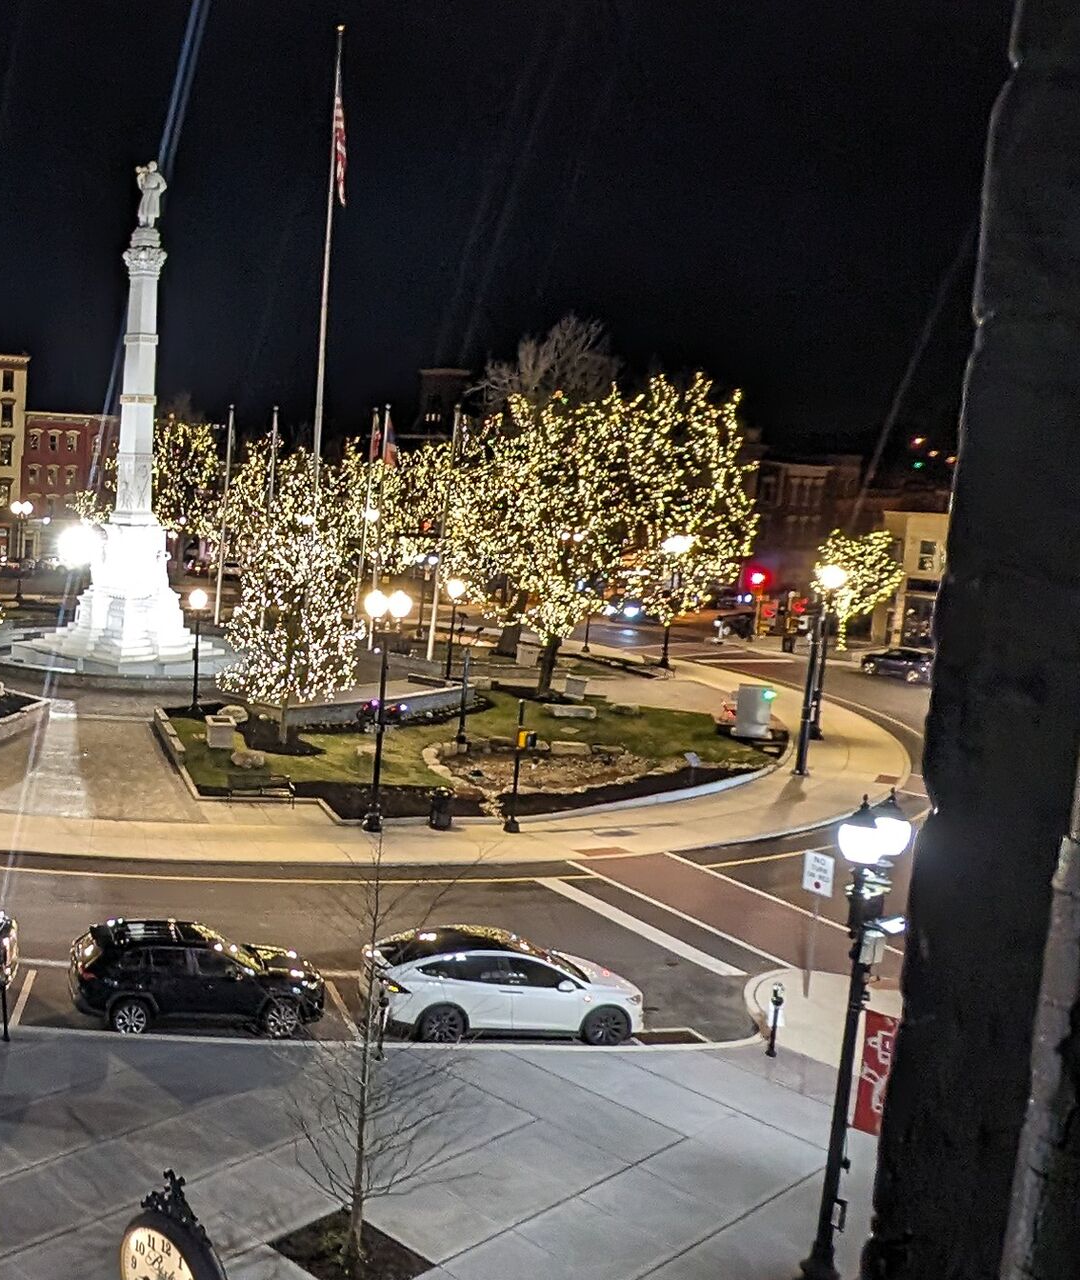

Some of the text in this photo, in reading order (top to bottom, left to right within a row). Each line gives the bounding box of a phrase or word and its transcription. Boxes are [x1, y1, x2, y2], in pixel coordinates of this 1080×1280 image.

[814, 856, 825, 865] NO
[135, 1239, 146, 1256] 10
[148, 1234, 156, 1251] 11
[161, 1239, 172, 1256] 12
[131, 1256, 137, 1269] 9
